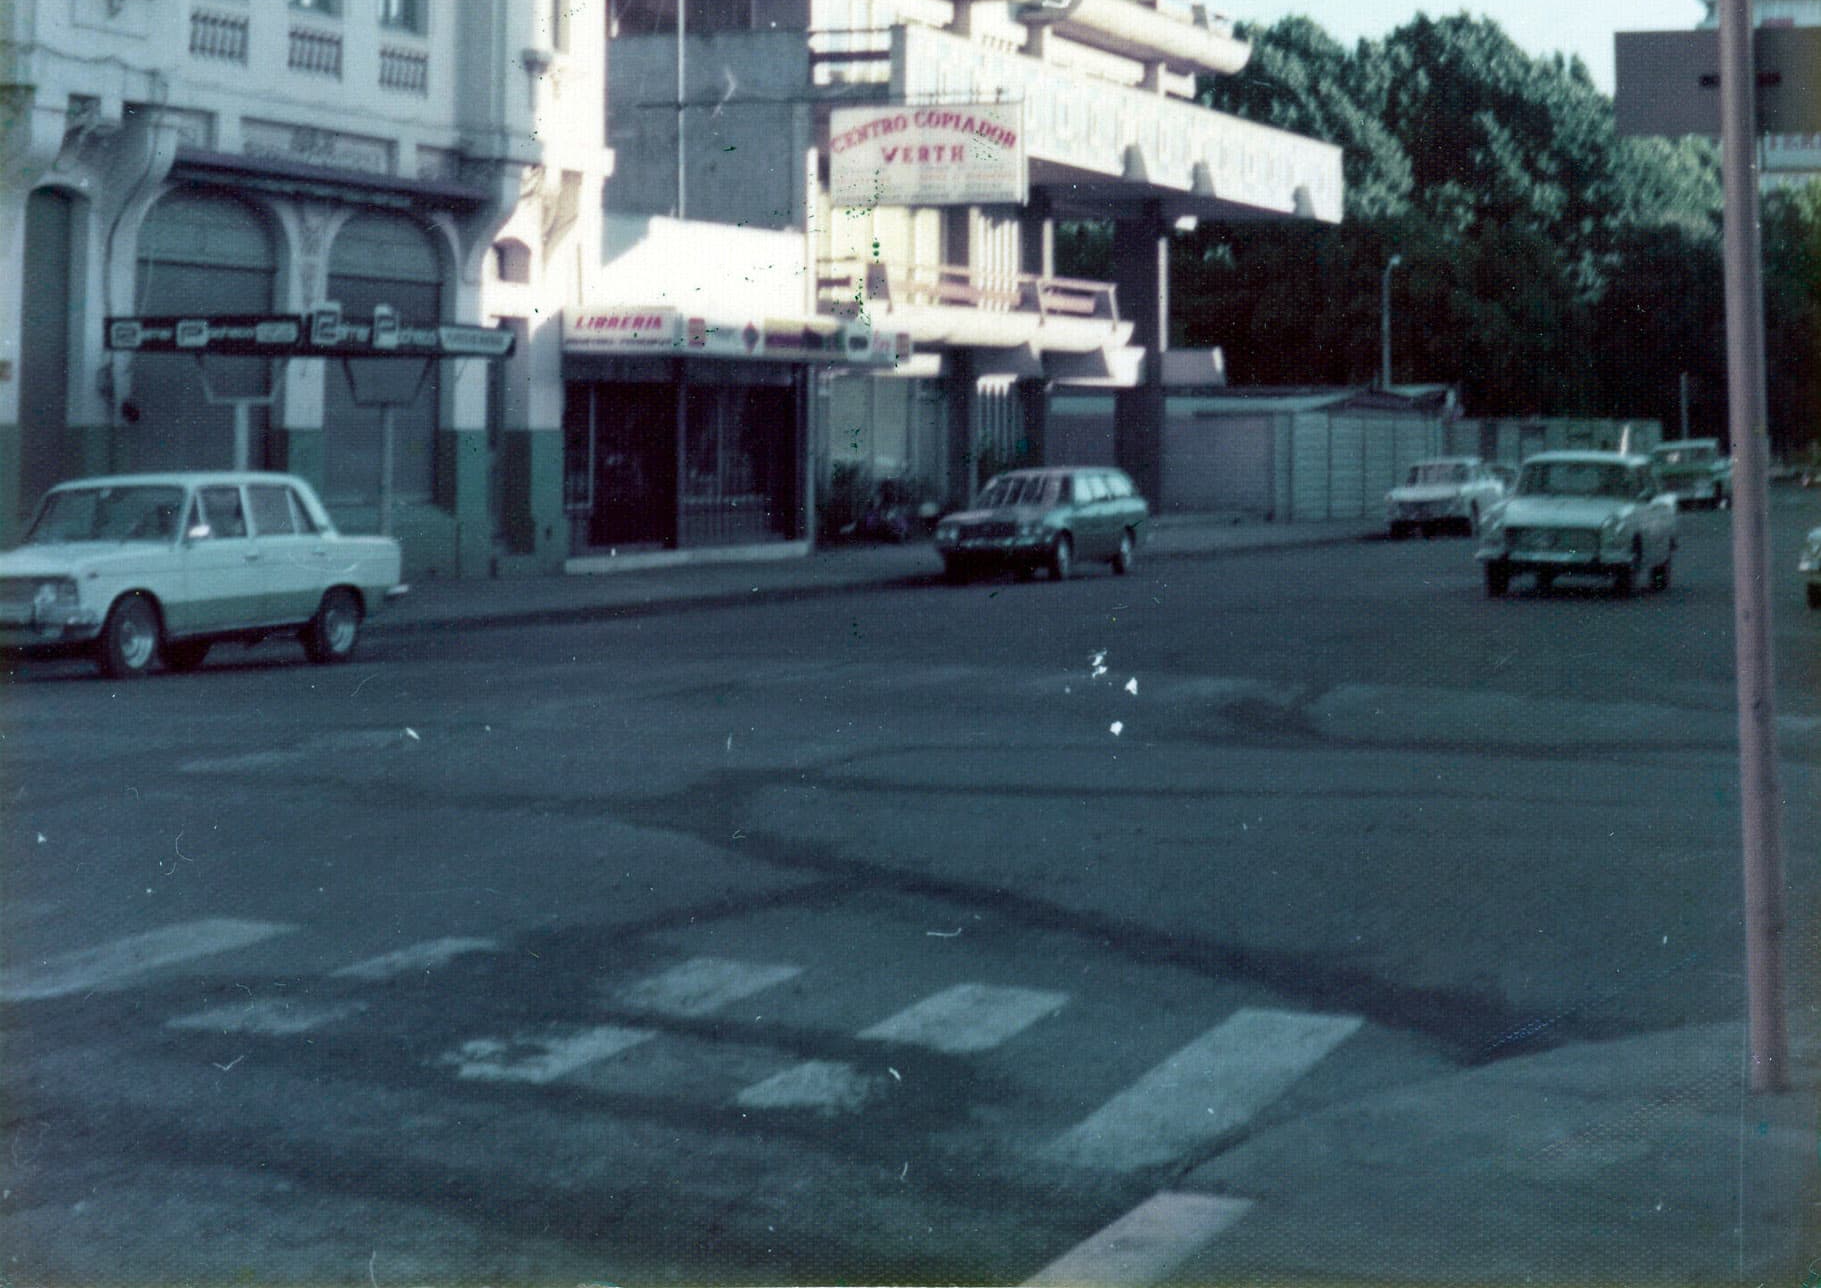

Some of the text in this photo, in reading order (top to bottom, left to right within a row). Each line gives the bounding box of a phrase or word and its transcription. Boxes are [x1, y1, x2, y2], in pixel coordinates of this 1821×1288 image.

[830, 109, 1017, 154] CENTRO COPIADOR
[881, 145, 966, 164] VERTH
[575, 315, 664, 330] LIBRERIA
